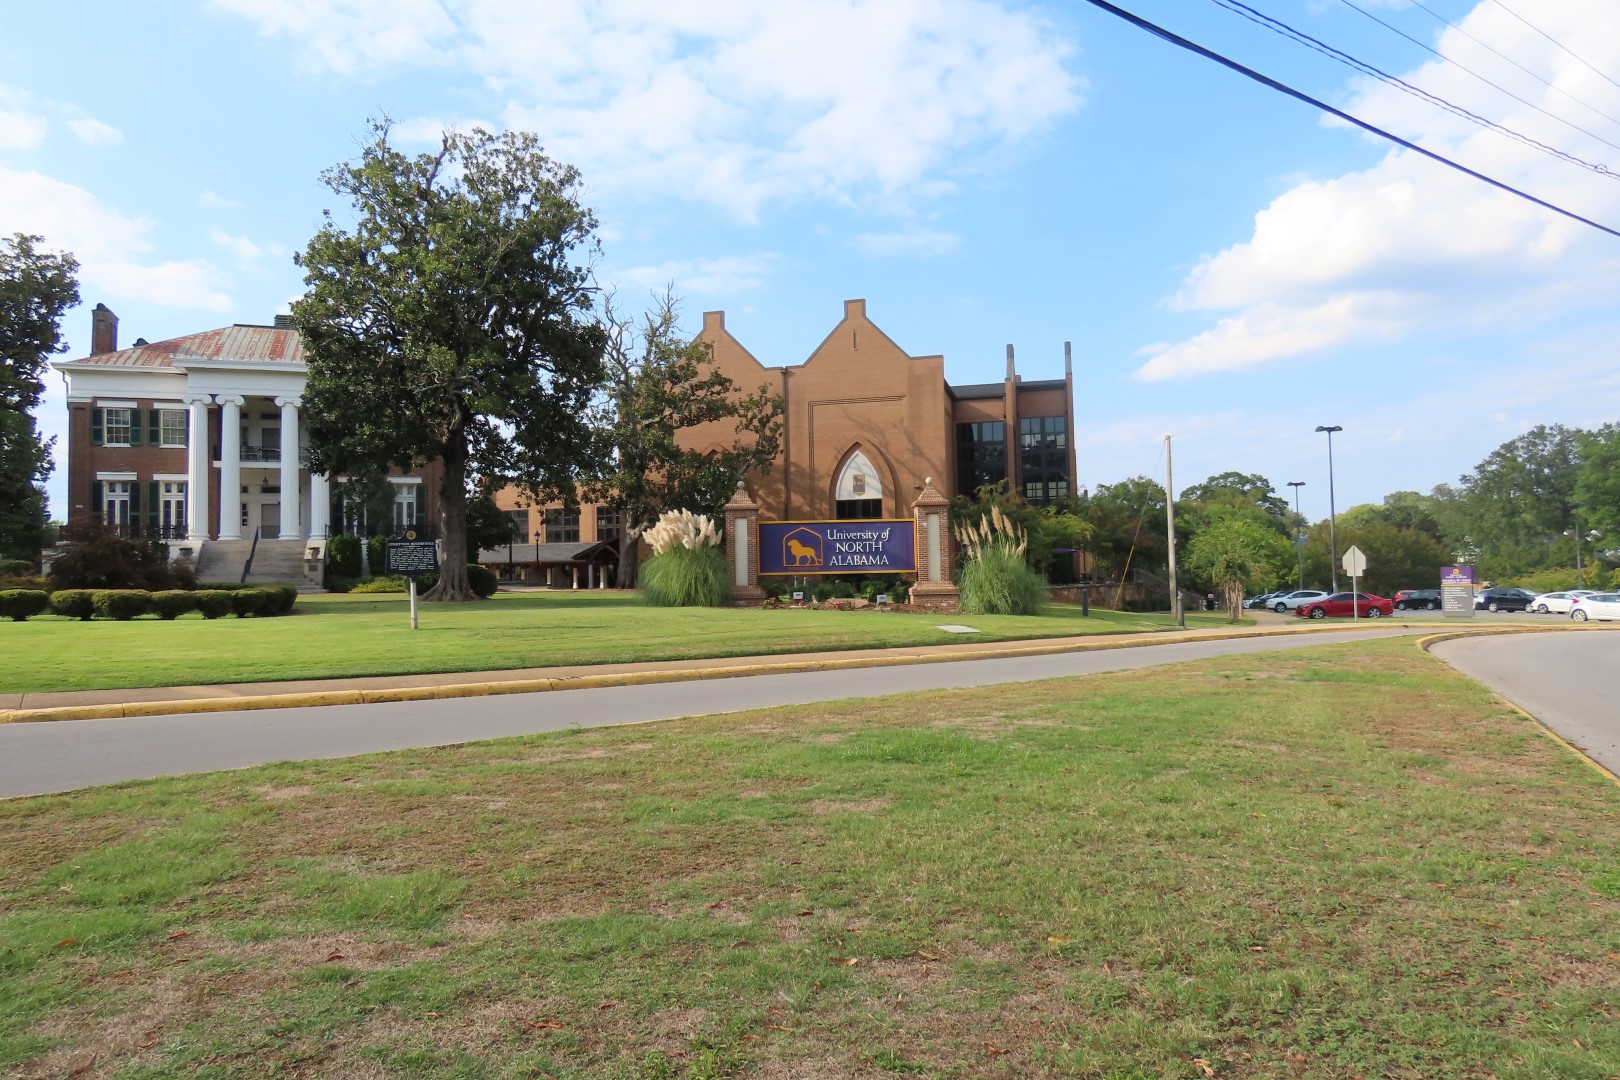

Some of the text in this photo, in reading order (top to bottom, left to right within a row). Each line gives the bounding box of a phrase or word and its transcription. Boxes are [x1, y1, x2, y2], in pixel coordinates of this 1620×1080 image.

[827, 528, 890, 541] University of
[836, 541, 882, 553] NORTH
[829, 555, 889, 566] ALABAMA
